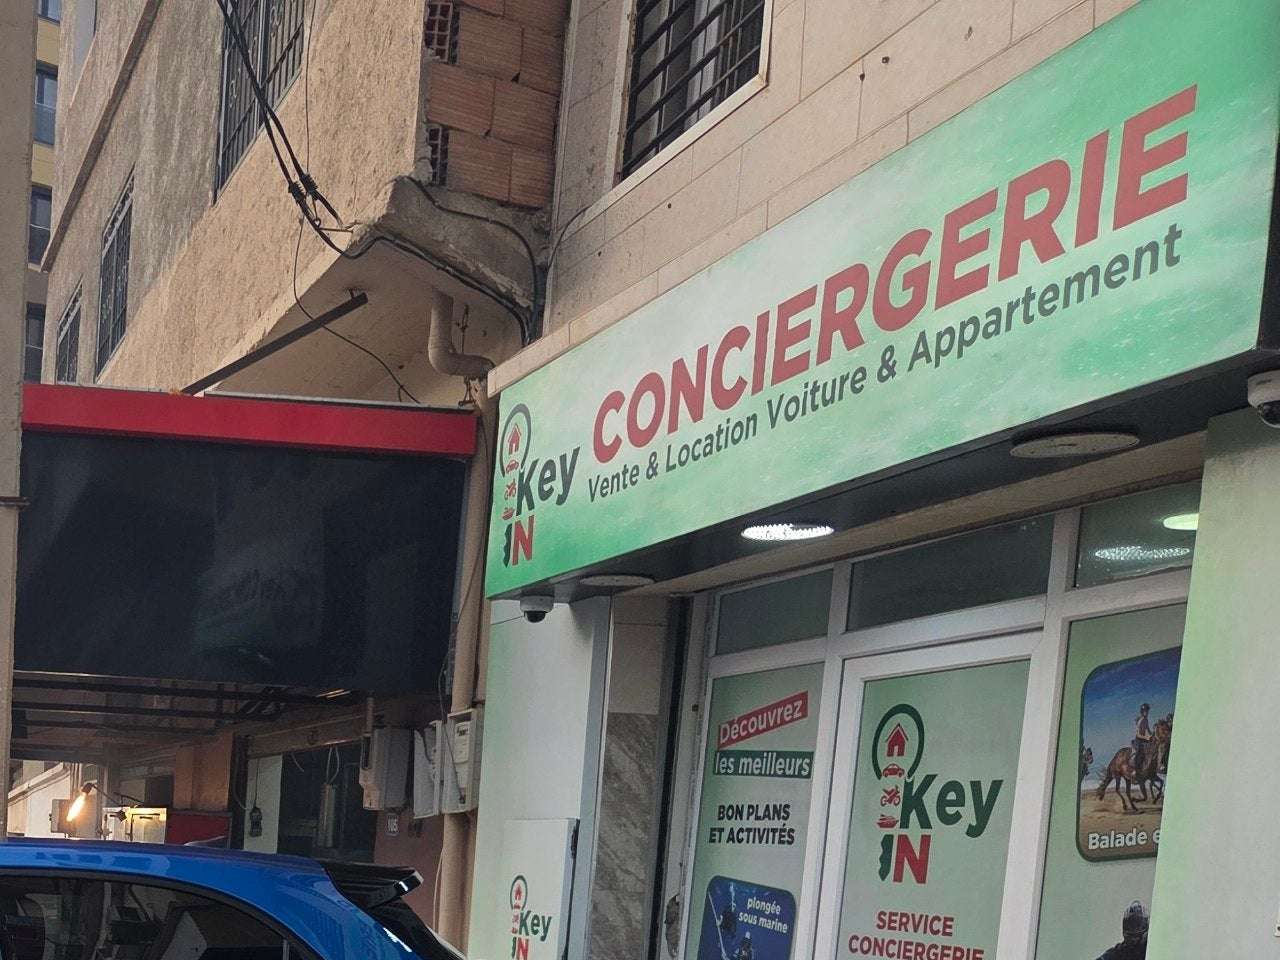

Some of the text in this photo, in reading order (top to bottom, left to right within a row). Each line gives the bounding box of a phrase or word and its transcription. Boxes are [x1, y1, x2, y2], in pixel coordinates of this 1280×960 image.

[592, 84, 1198, 464] CONCIERGERIE
[588, 223, 1183, 502] Vente & Location Voiture & Appartement
[516, 446, 580, 516] Key
[720, 700, 803, 744] Découvrez
[715, 752, 810, 776] les meilleurs
[718, 804, 791, 821] BON PLANS
[899, 773, 1004, 838] Key
[709, 823, 795, 845] ET ACTIVITÉS
[1088, 828, 1147, 850] Balade
[747, 897, 781, 915] plongée
[519, 910, 552, 942] Key
[738, 911, 788, 933] sous marine
[876, 910, 954, 937] SERVICE
